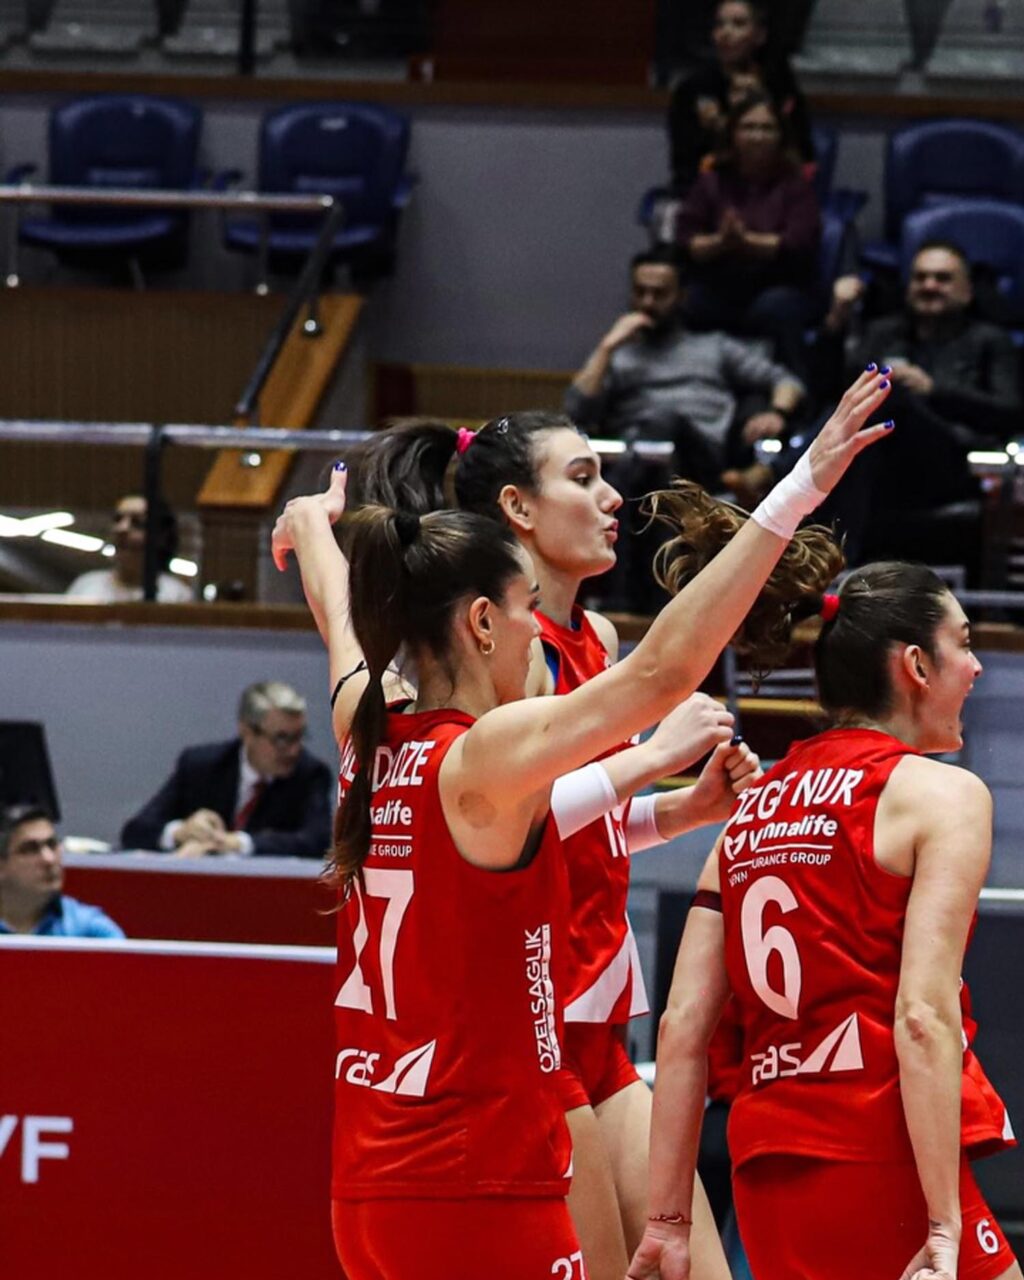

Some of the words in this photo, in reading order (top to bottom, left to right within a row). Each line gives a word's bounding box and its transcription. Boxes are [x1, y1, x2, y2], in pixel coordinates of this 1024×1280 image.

[789, 768, 864, 807] NUR
[378, 844, 413, 857] GROUP
[790, 852, 831, 866] GROUP
[740, 875, 802, 1021] 6
[976, 1218, 999, 1254] 6
